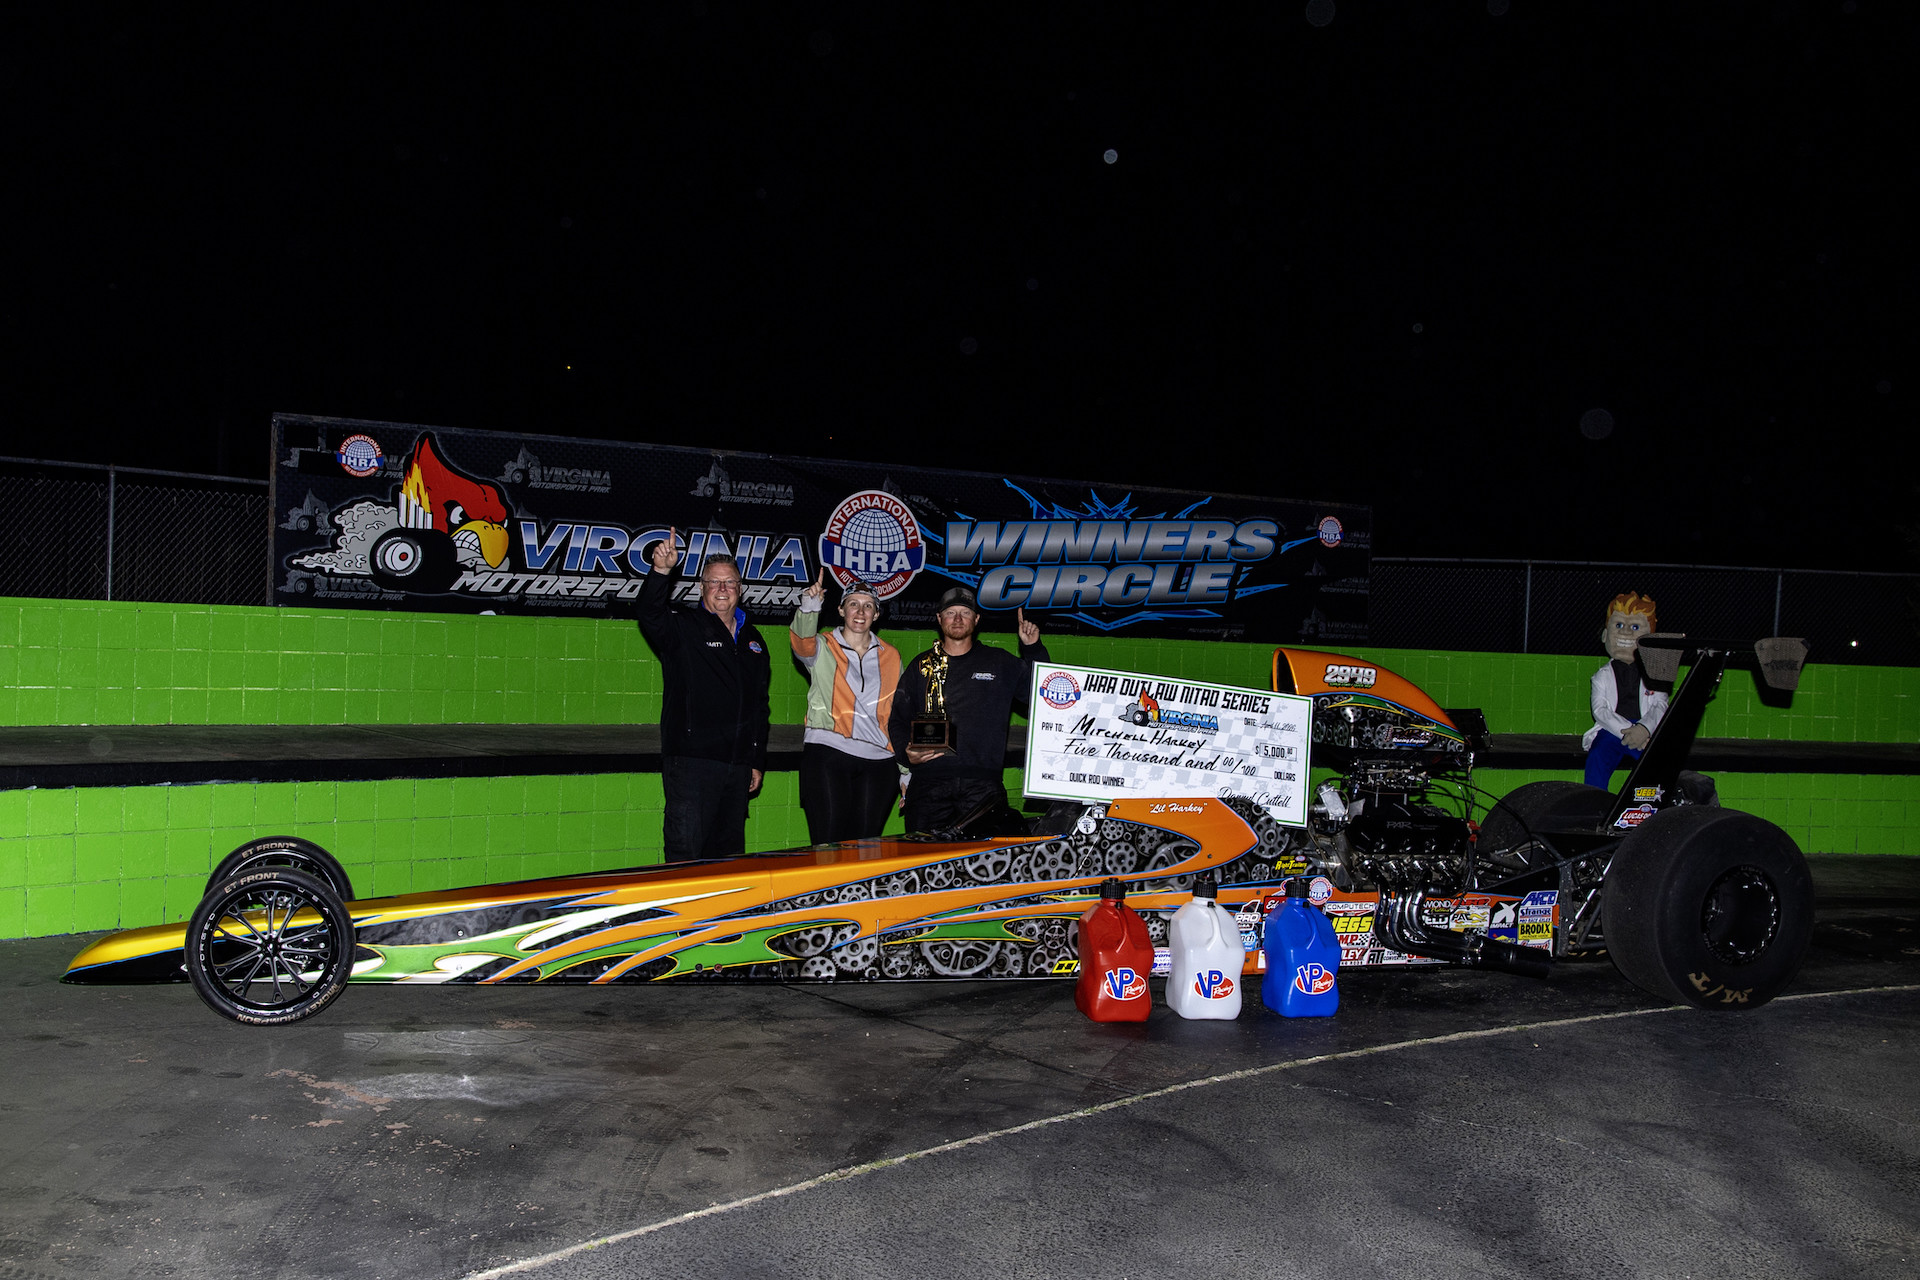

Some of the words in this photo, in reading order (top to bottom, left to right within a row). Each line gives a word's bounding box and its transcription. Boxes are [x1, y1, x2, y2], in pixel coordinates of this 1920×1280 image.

[340, 434, 381, 456] INTERNATIONAL
[342, 454, 379, 467] IHRA
[542, 466, 612, 487] VIRGINIA
[528, 482, 588, 492] MOTORSPORTS
[588, 486, 612, 494] PARK
[731, 480, 794, 499] VIRGINIA
[828, 495, 916, 545] INTERNATIONAL
[946, 519, 1279, 566] WINNERS
[1319, 531, 1342, 541] IHRA
[520, 521, 809, 583] VIRGINIA
[832, 544, 912, 573] IHRA
[312, 590, 380, 600] MOTORSPORTS
[380, 592, 405, 601] PARK
[450, 570, 702, 602] MOTORSPOTS
[976, 562, 1237, 611] CIRCLE
[524, 600, 585, 608] MOTORSPORTS
[1041, 671, 1080, 691] INTERNATIONAL
[1323, 664, 1377, 685] 2949
[1043, 689, 1077, 701] IHRA
[1083, 673, 1118, 695] IHRA
[1119, 678, 1179, 702] OUTLAW
[1180, 685, 1220, 708] NITRO
[1221, 691, 1271, 715] SERIES
[1041, 721, 1055, 731] PAY
[1055, 723, 1064, 733] TO:
[1160, 709, 1219, 731] VIRGINIA
[1064, 738, 1100, 756] Five
[1104, 742, 1186, 768] Thousand
[1185, 754, 1221, 771] and
[1255, 745, 1260, 755] $
[1069, 772, 1087, 784] QUICK
[1087, 775, 1101, 785] ROD
[1101, 776, 1125, 788] WINNER
[1274, 771, 1296, 782] DOLLARS
[1636, 789, 1656, 797] JEGS
[1623, 812, 1644, 820] LUCAS
[241, 848, 255, 859] ET
[256, 842, 291, 852] FRONT
[223, 880, 238, 894] ET
[240, 872, 280, 886] FRONT
[1310, 890, 1329, 900] HRA
[1326, 902, 1375, 911] COMPUTECH
[1236, 914, 1260, 922] PRO
[1520, 924, 1551, 935] BRODIX
[312, 963, 339, 999] WELD
[1105, 967, 1135, 999] VP
[1195, 969, 1224, 999] VP
[1296, 963, 1325, 994] VP
[305, 982, 343, 1016] MICKEY
[235, 1013, 303, 1025] THOMPSON
